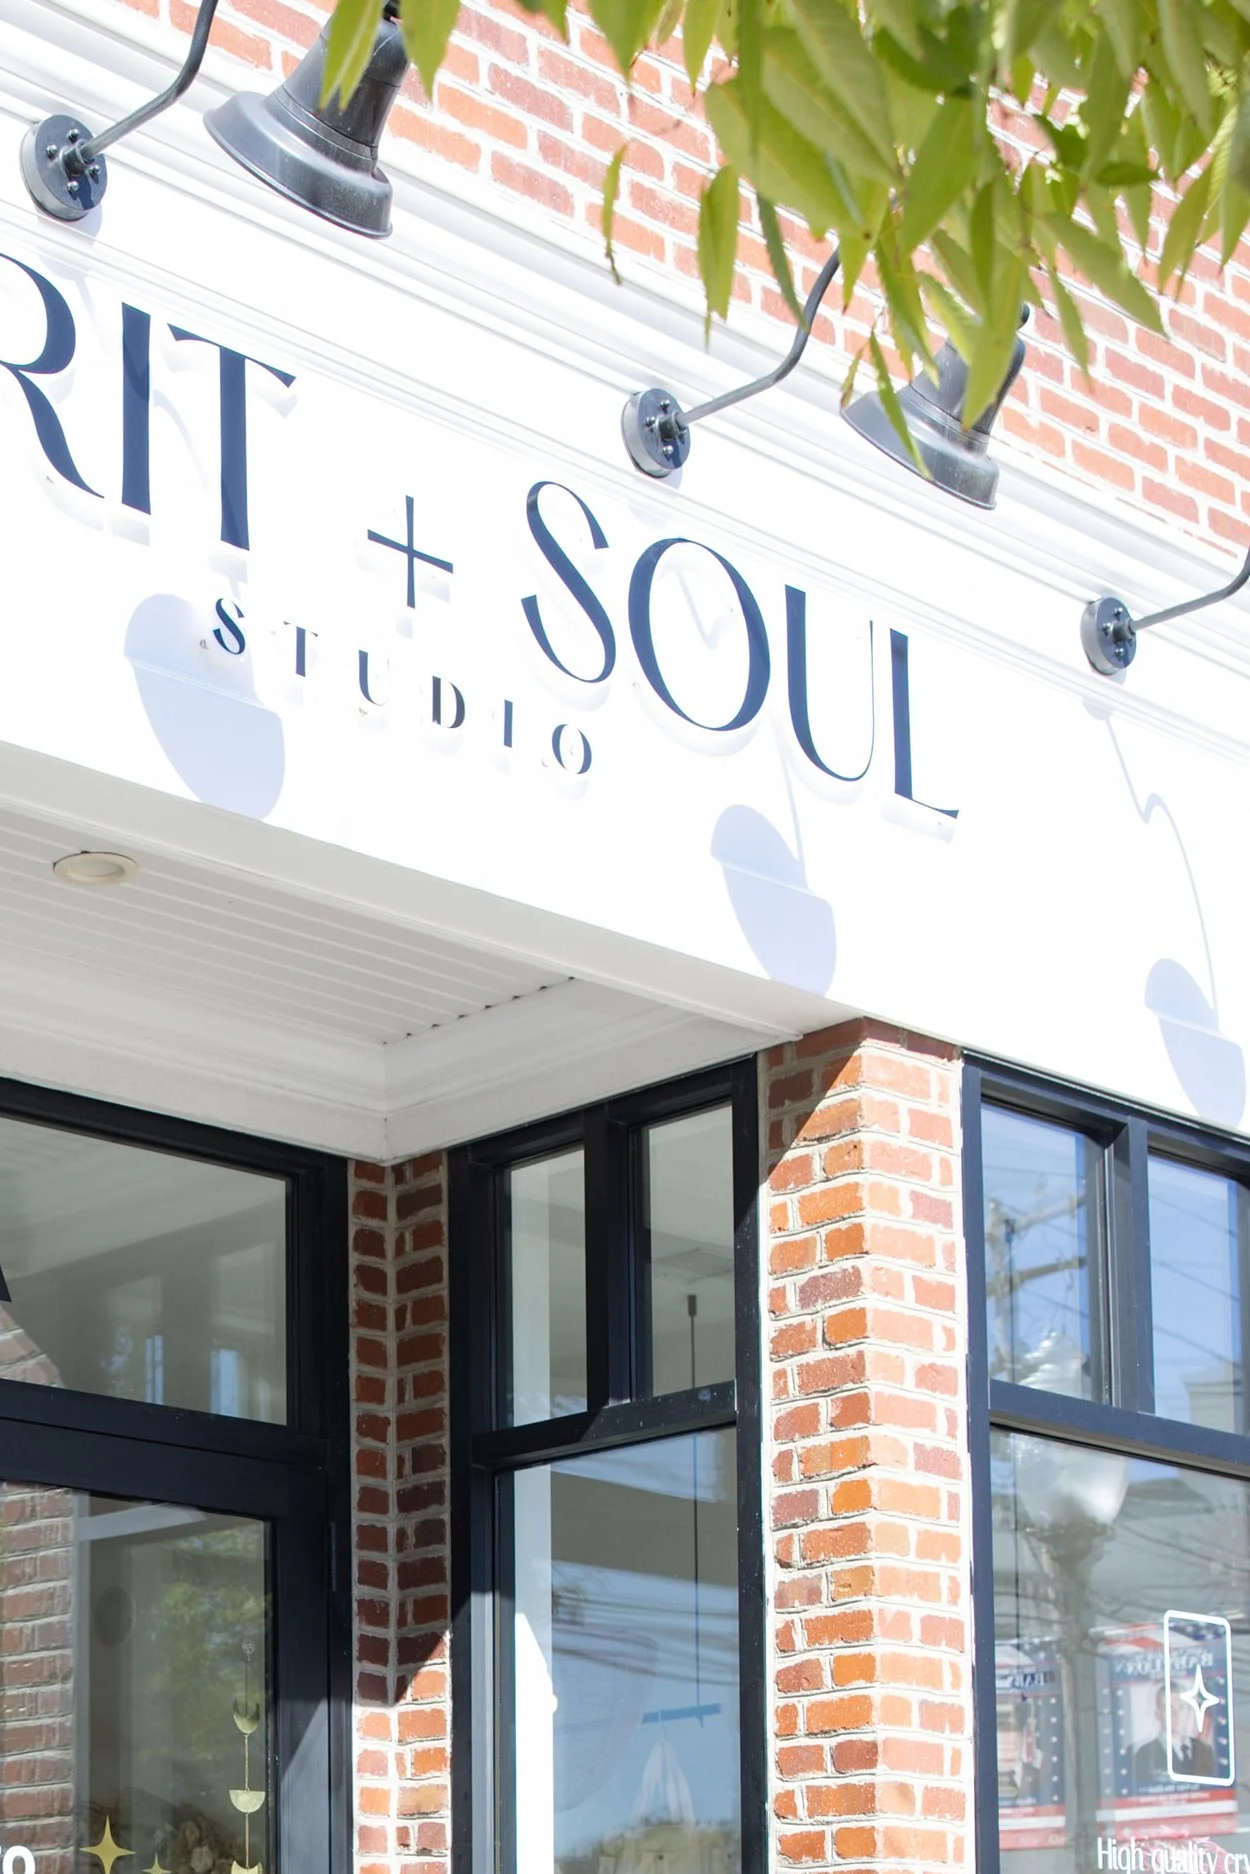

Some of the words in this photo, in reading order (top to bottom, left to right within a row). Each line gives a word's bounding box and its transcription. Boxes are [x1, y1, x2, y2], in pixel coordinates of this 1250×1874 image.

[212, 597, 593, 775] STUDIO
[367, 496, 454, 608] +
[521, 481, 959, 819] SOUL
